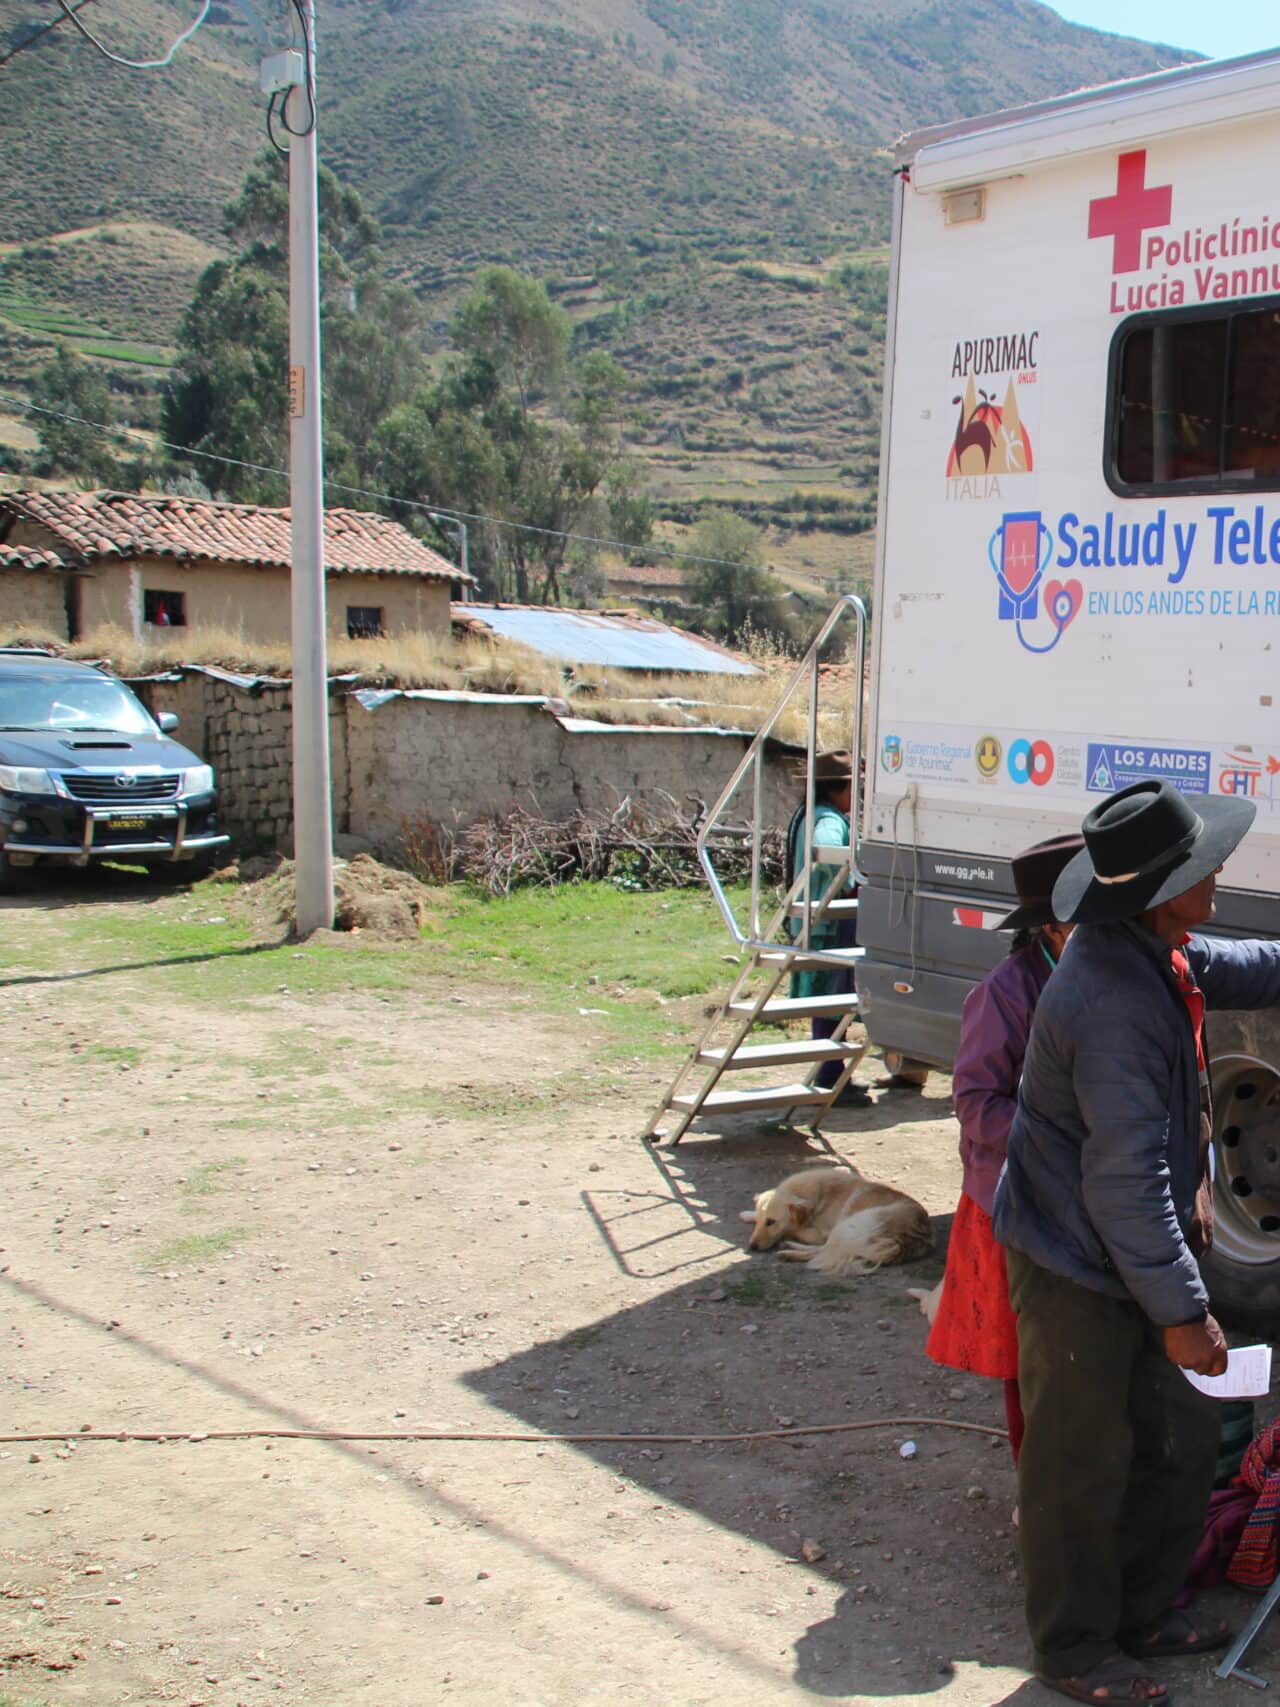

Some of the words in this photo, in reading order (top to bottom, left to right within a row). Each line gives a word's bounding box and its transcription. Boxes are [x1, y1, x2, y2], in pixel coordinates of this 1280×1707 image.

[1110, 273, 1185, 314] Lucia
[951, 331, 1039, 379] APURIMAC
[945, 475, 1002, 501] ITALIA
[1056, 508, 1167, 568] Salud
[1168, 521, 1198, 584] y
[1087, 590, 1110, 616] EN
[1113, 590, 1144, 616] LOS
[1146, 589, 1206, 616] ANDES
[1210, 589, 1233, 616] DE
[1236, 589, 1260, 616] LA
[1114, 749, 1145, 767] LOS
[1149, 753, 1208, 772] ANDES
[1219, 768, 1262, 797] GHT
